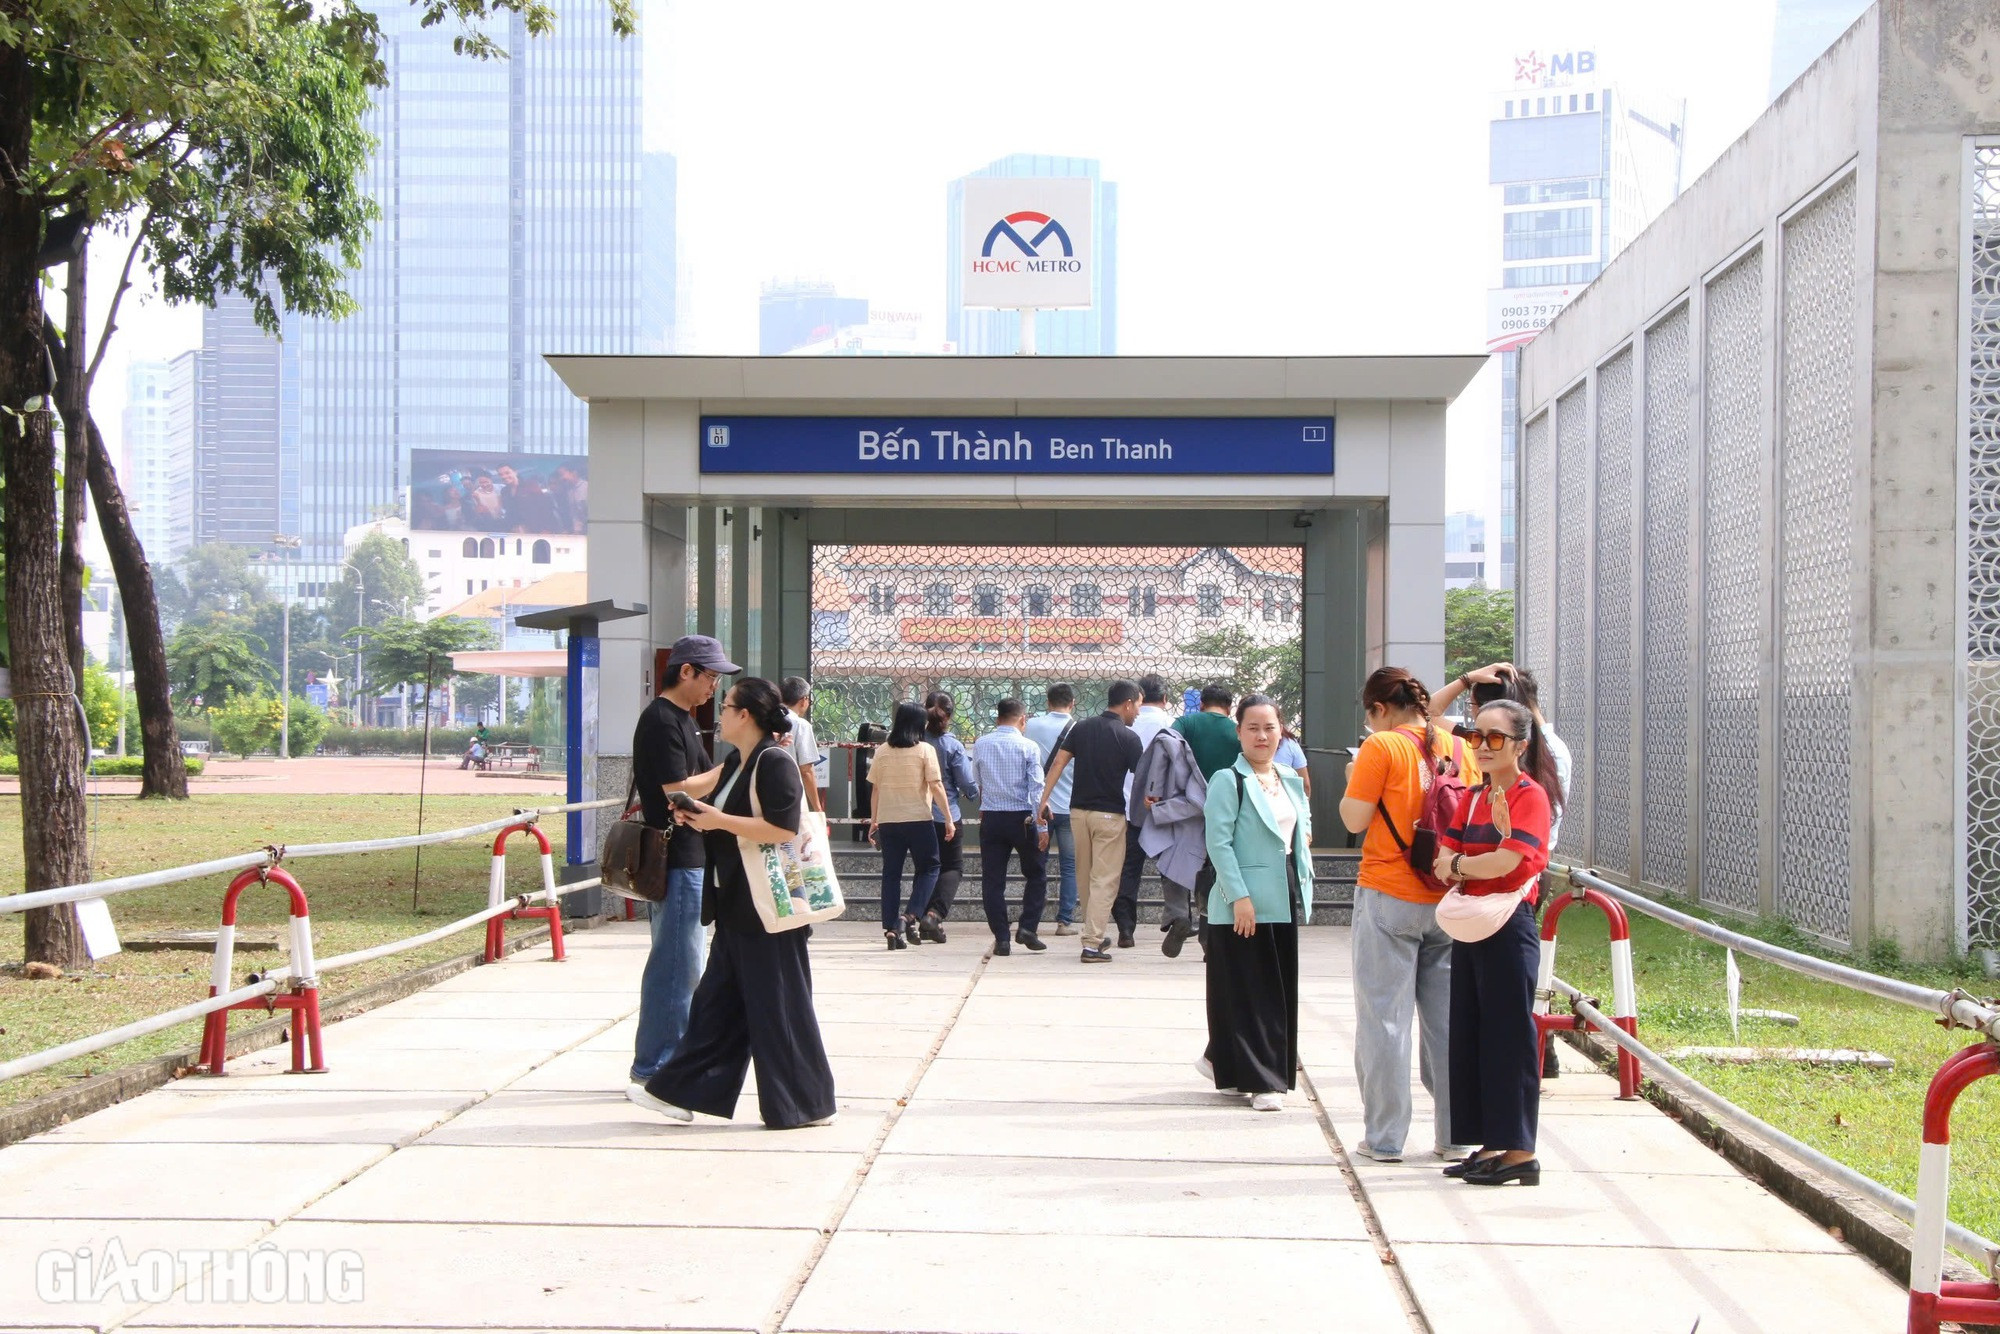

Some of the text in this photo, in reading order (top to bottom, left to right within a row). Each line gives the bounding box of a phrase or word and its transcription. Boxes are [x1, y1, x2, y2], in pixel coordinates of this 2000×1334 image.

[1550, 51, 1595, 76] MB
[973, 260, 1081, 273] HCMC METRO
[870, 311, 922, 323] SUNWAH
[1501, 306, 1530, 317] 0903
[1533, 305, 1547, 315] 79
[1501, 318, 1547, 330] 0906 68
[714, 435, 724, 445] 01
[858, 427, 1172, 460] Bến Thành Ben Thanh
